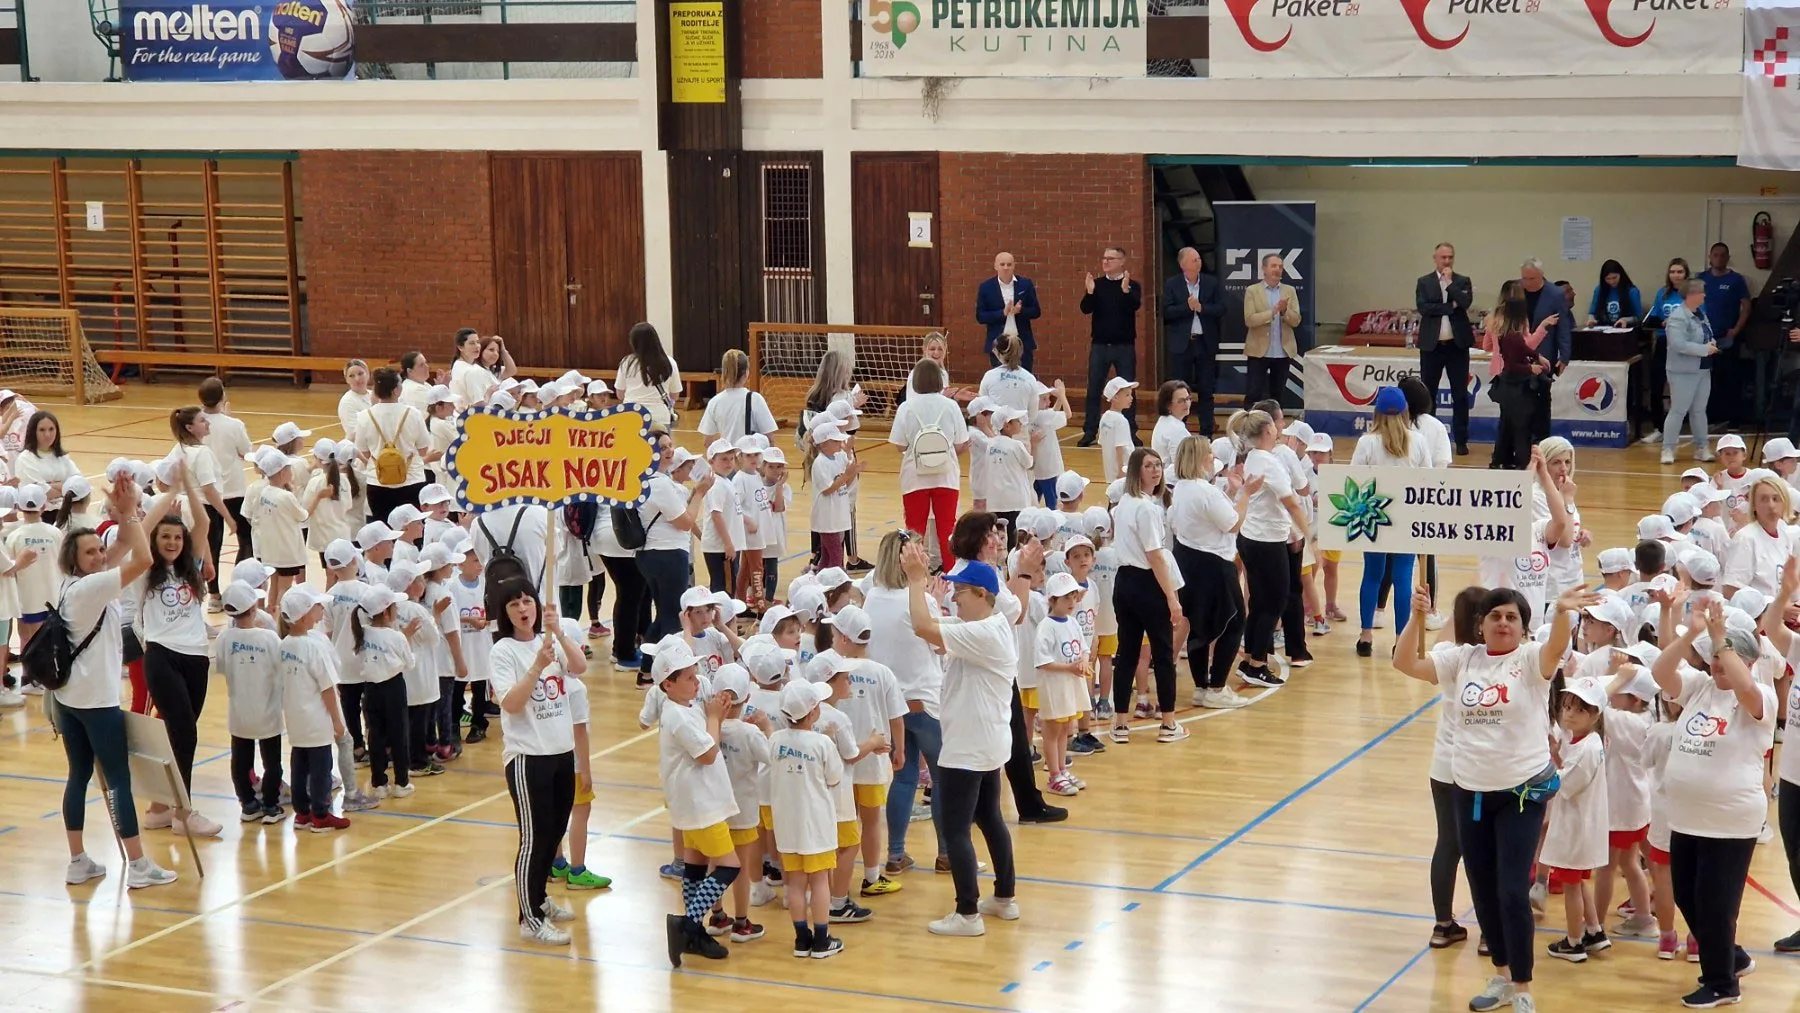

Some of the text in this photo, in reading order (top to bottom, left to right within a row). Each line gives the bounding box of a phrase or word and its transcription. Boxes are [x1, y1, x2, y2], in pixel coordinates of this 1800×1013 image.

[932, 0, 1140, 29] PETROKEMIJA
[1272, 0, 1360, 17] Paket 24
[134, 5, 260, 41] molten
[870, 41, 890, 50] 1968
[950, 35, 1121, 52] KUTINA
[131, 46, 262, 69] For the real game
[874, 50, 895, 59] 2018
[92, 214, 98, 225] 1
[917, 226, 923, 238] 2
[494, 423, 616, 449] DJEČJI VRTIĆ
[1571, 430, 1620, 439] www.hrs.hr
[480, 457, 628, 494] SISAK NOVI
[1404, 481, 1524, 509] DJEČJI VRTIĆ
[1412, 521, 1515, 542] SISAK STARI
[849, 674, 865, 683] AIR
[779, 745, 802, 758] FAIR
